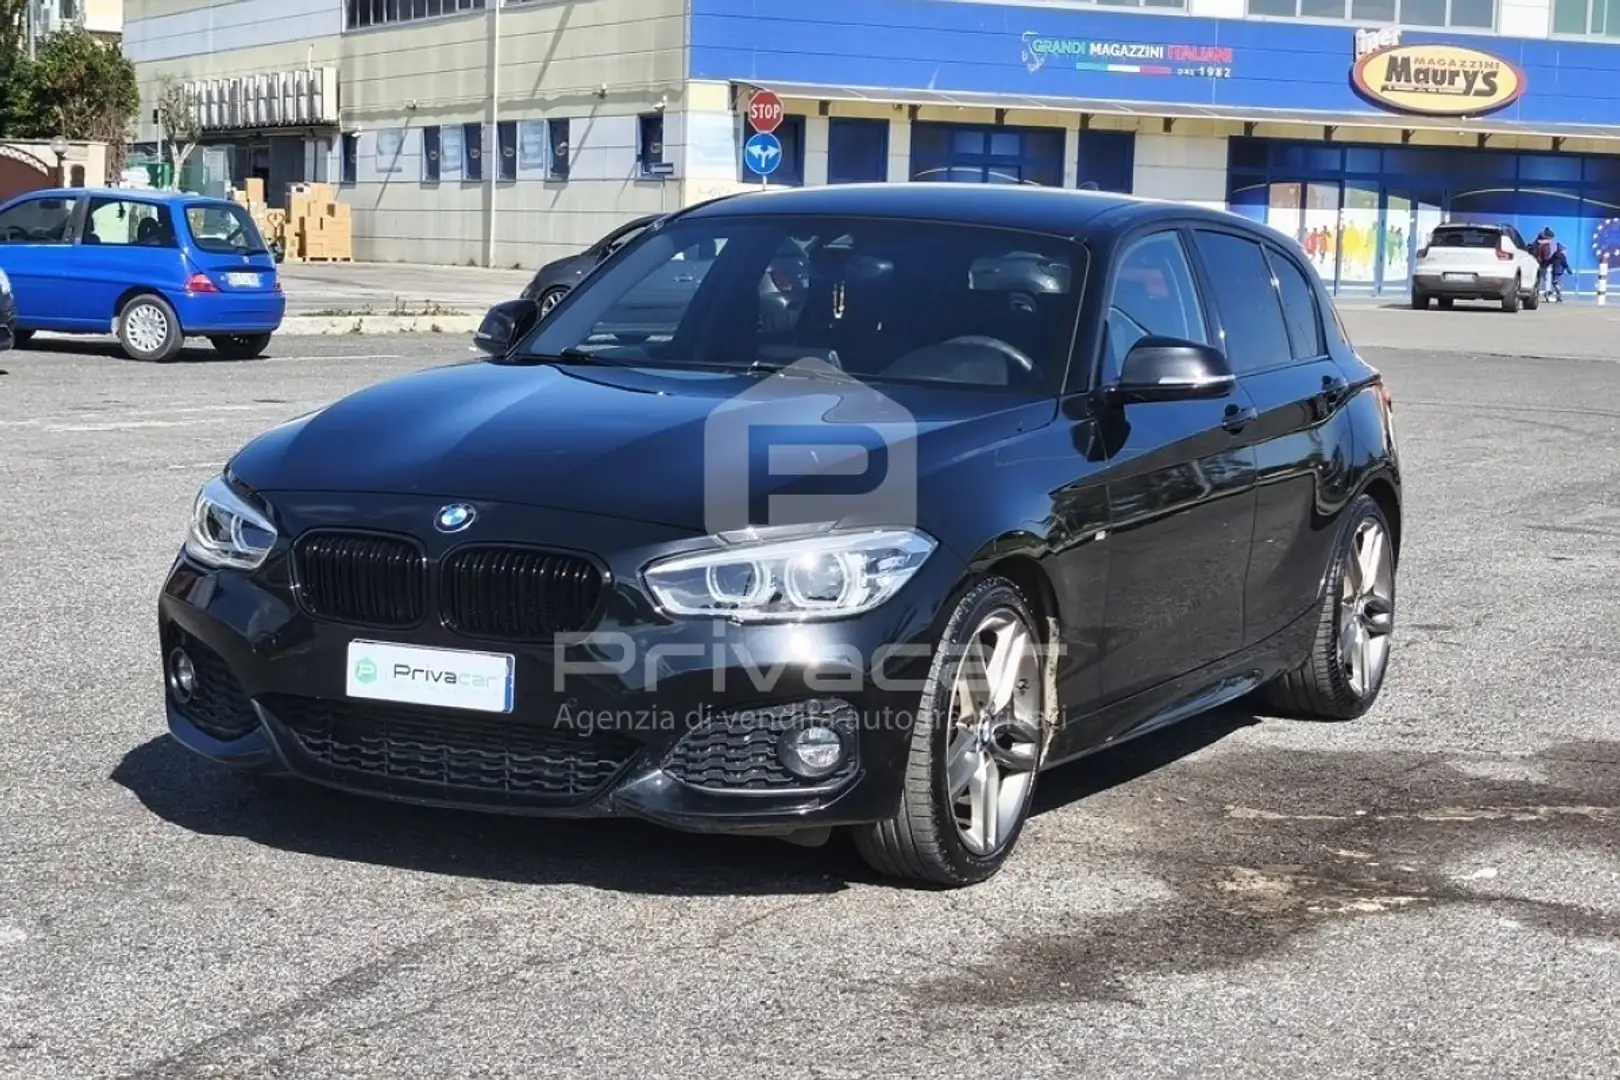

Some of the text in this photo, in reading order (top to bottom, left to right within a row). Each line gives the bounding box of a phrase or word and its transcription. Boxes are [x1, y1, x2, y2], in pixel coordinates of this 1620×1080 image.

[1032, 39, 1233, 64] GRANDI MAGAZZINI ITALIANI
[1198, 66, 1232, 78] 1982
[1413, 57, 1500, 70] MAGAZZINI
[1384, 55, 1498, 97] Maury's
[751, 103, 781, 119] STOP
[393, 663, 500, 689] Privacar
